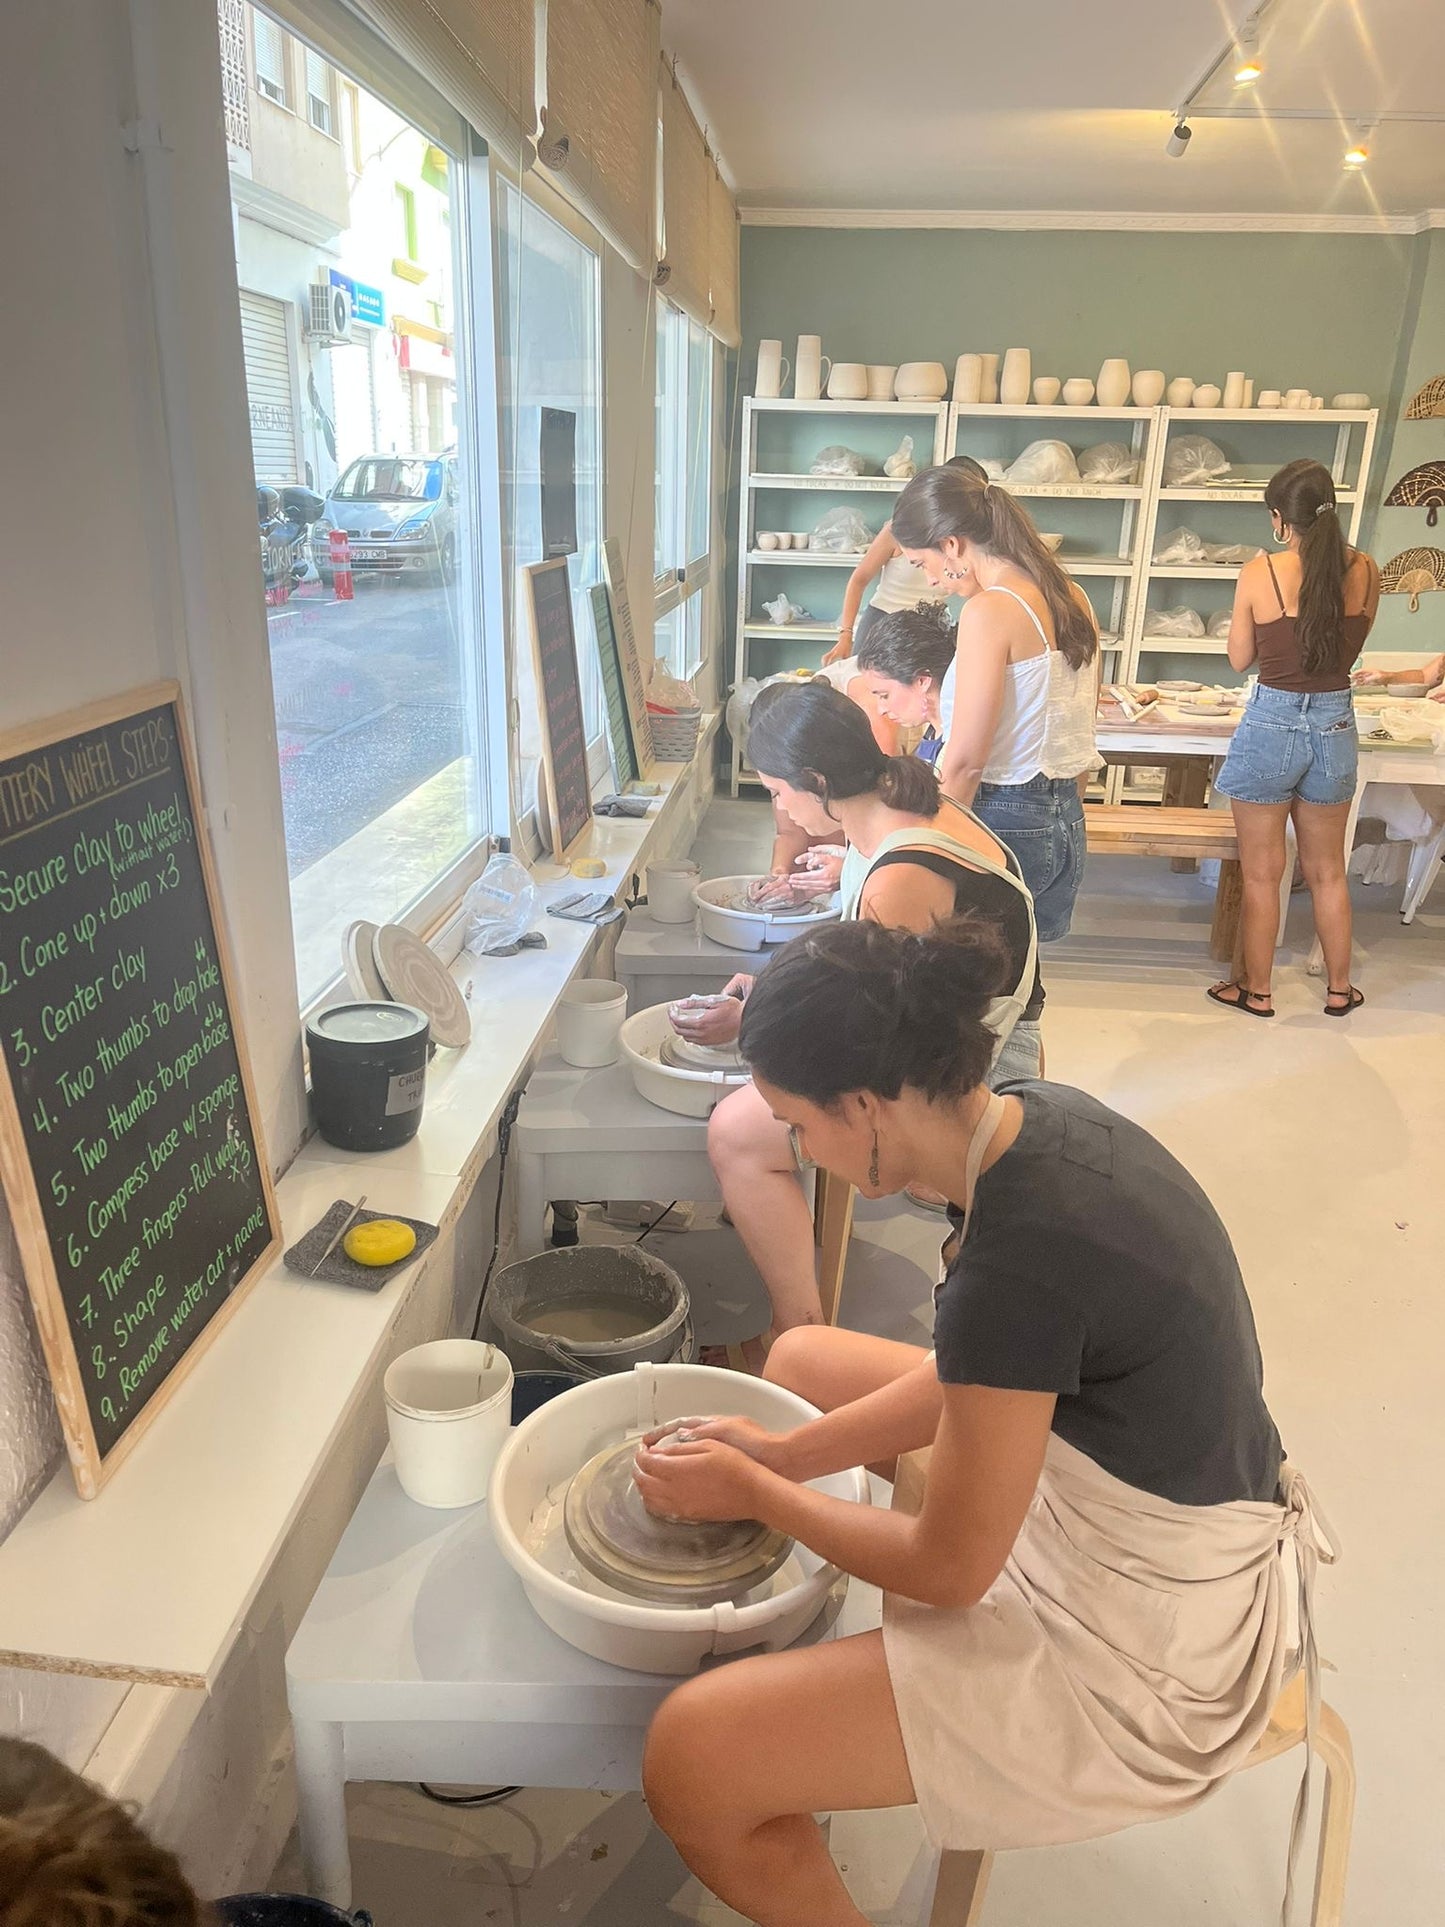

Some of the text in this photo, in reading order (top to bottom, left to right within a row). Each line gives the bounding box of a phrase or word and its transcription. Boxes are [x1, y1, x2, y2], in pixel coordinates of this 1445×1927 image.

[59, 741, 120, 806] WHEEL
[120, 716, 170, 780] STEPS
[0, 792, 182, 913] Secure clay to wheel
[0, 961, 19, 995] 2.
[20, 931, 70, 978] Cone
[72, 912, 97, 955] up
[109, 883, 152, 920] down
[155, 852, 181, 894] x3
[11, 945, 147, 1067] 3. Center clay
[32, 1097, 59, 1134] 4.
[55, 1065, 95, 1108] Two
[96, 1014, 151, 1075] thumbs
[151, 997, 170, 1028] to
[50, 1170, 76, 1207] 5.
[72, 1137, 108, 1177] Two
[106, 1079, 158, 1141] thumbs
[156, 1061, 174, 1092] to
[66, 1073, 239, 1268] 6. Compress base w/ sponge
[78, 1293, 99, 1330] 7.
[98, 1246, 141, 1302] Three
[113, 1274, 168, 1348] Shape
[119, 1325, 170, 1402] Remove
[168, 1274, 209, 1332] water,
[206, 1248, 225, 1287] cut
[233, 1205, 265, 1253] name
